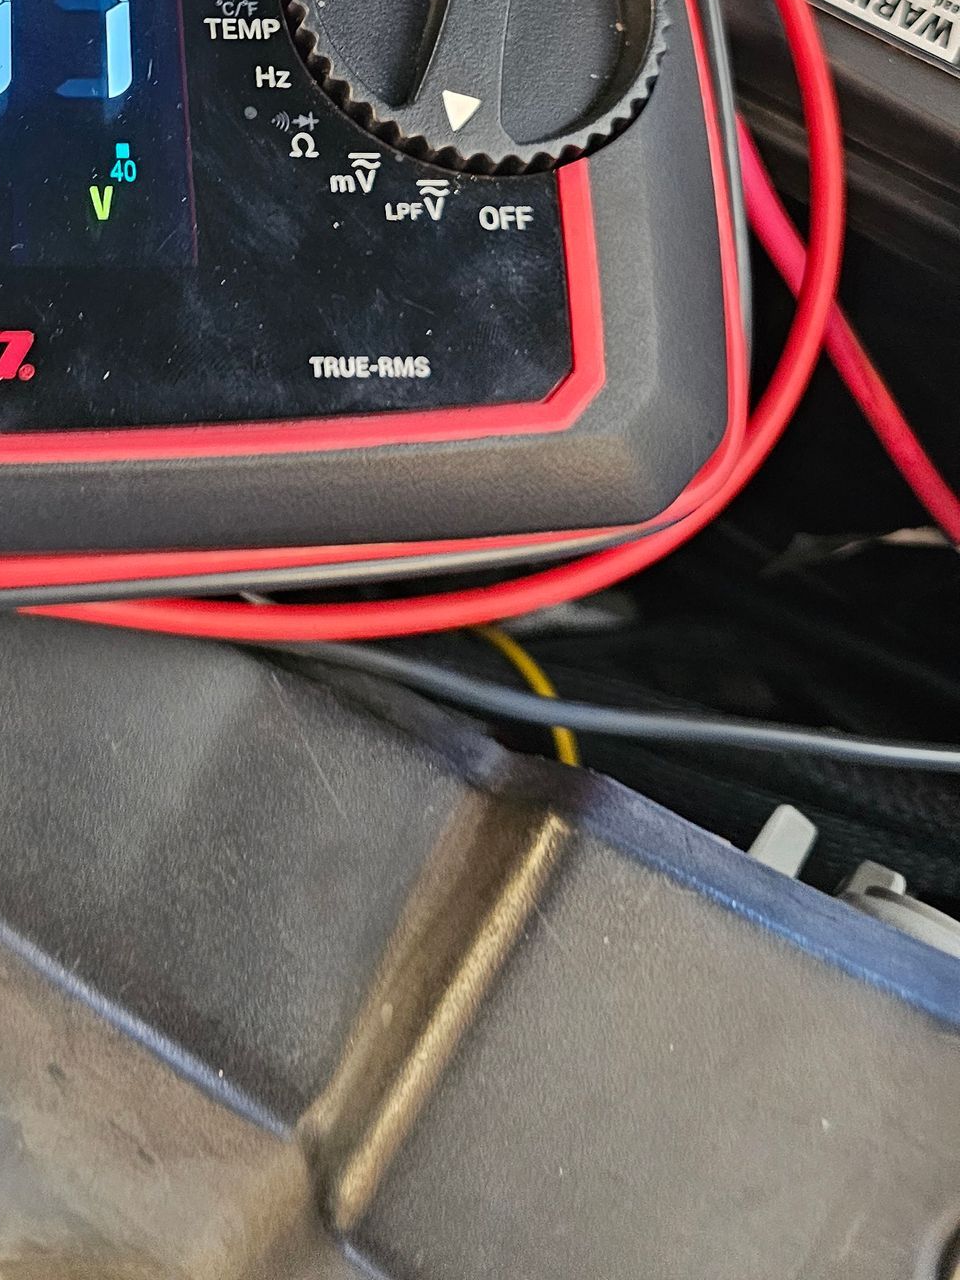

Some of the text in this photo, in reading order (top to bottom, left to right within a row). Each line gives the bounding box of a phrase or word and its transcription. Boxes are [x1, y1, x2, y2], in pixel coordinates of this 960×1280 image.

[203, 17, 281, 40] TEMP
[255, 65, 292, 89] Hz
[110, 159, 137, 183] 40
[329, 169, 377, 193] mV
[89, 185, 114, 221] V
[478, 205, 534, 231] OFF
[308, 355, 432, 379] TRUE-RMS
